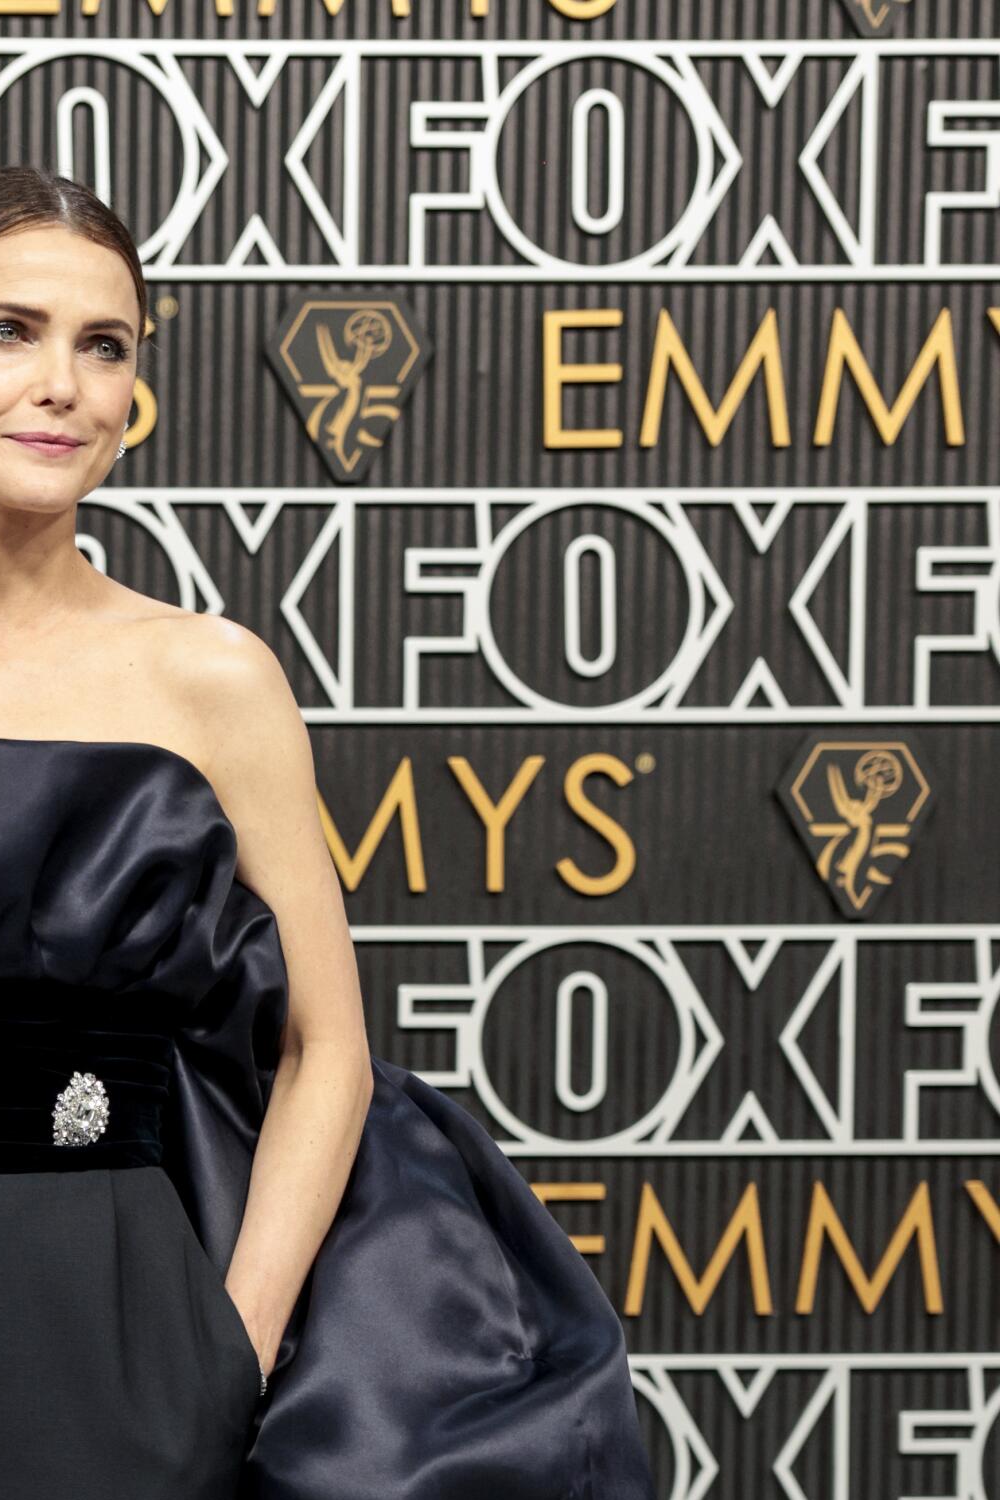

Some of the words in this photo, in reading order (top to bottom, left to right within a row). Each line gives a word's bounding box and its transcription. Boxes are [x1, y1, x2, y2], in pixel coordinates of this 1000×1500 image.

[346, 39, 878, 282] FOX
[542, 308, 1000, 449] EMM
[340, 487, 868, 722] FOX
